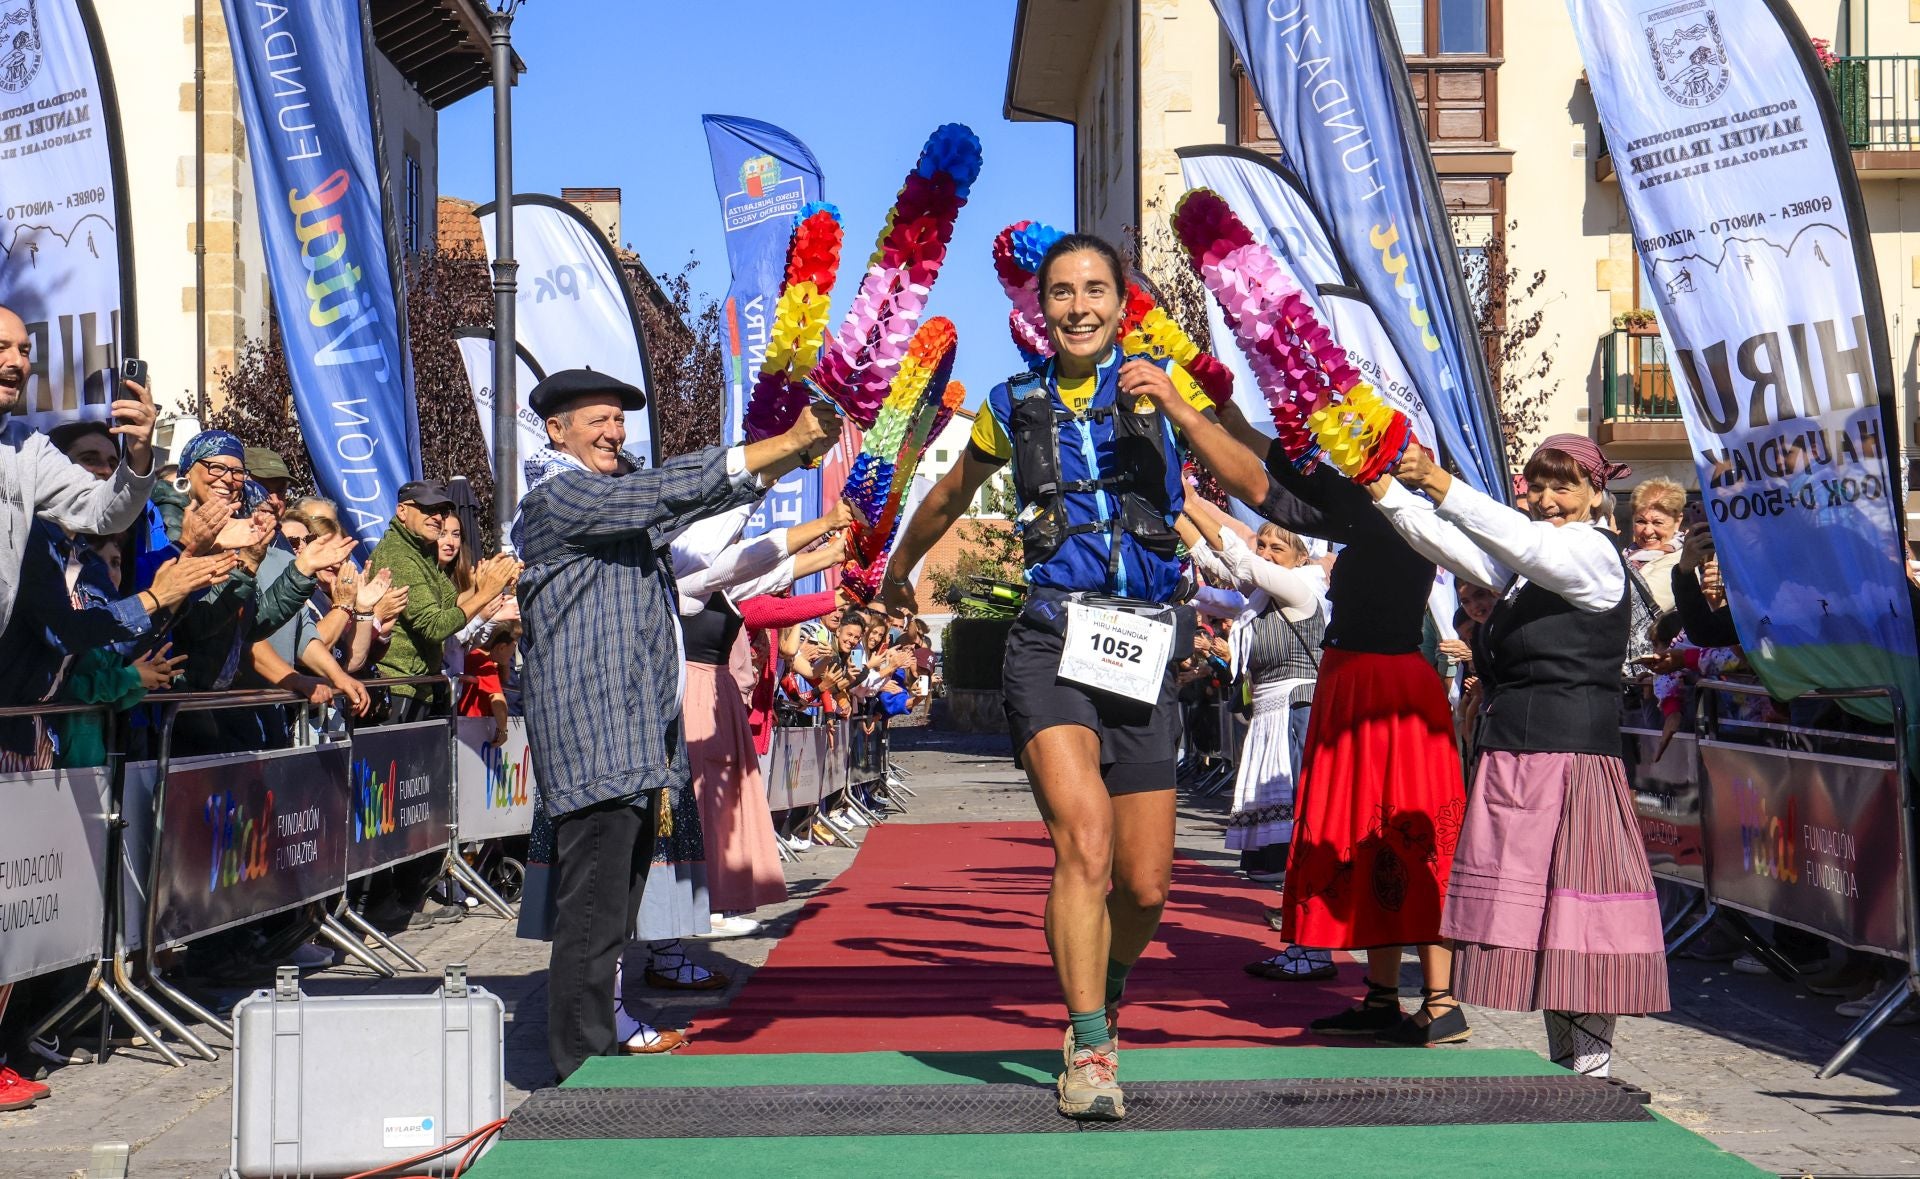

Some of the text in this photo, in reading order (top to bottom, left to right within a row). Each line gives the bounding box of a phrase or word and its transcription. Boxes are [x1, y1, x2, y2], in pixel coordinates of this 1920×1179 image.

[1091, 633, 1143, 664] 1052
[1093, 621, 1111, 631] HIRU
[1111, 625, 1148, 642] HAUNDIAK
[399, 772, 431, 801] FUNDACIÓN
[481, 741, 530, 810] Vital
[353, 757, 397, 843] Vital
[400, 801, 430, 828] FUNDAZIOA
[277, 804, 321, 838] FUNDACIÓN
[1732, 777, 1798, 885] Vital
[204, 789, 274, 893] Vital
[276, 839, 319, 871] FUNDAZIOA
[1804, 824, 1857, 863] FUNDACIÓN
[0, 848, 63, 890] FUNDACIÓN
[1806, 860, 1860, 900] FUNDAZIOA
[385, 1125, 422, 1133] MYLAPS
